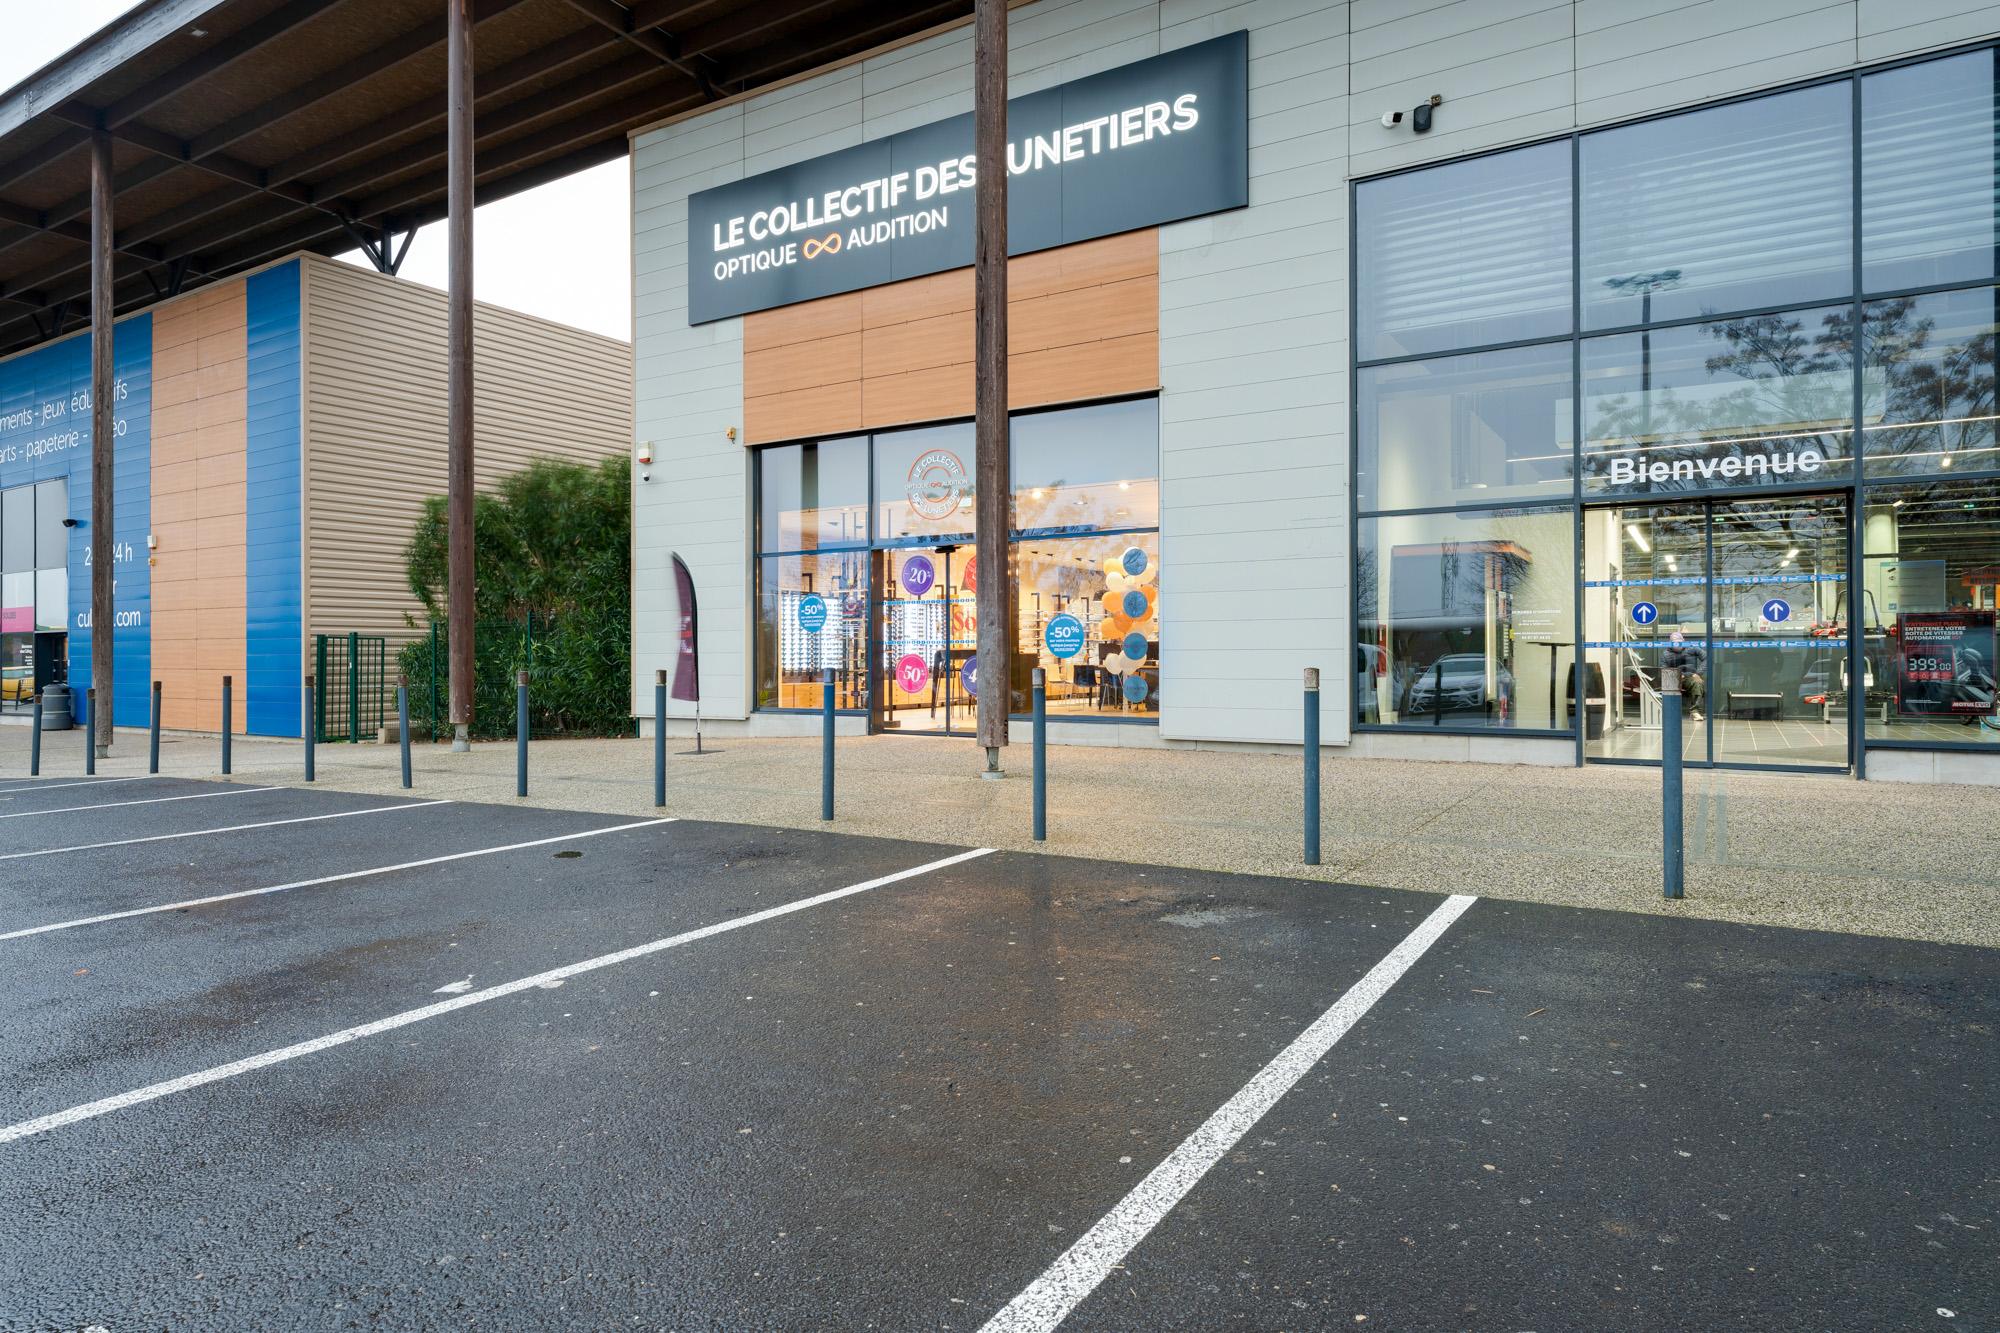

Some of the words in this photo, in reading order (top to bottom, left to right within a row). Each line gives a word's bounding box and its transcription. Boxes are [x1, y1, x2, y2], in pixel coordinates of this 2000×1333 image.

[713, 216, 745, 251] LE
[749, 172, 909, 241] COLLECTIF
[915, 154, 976, 200] DES
[1006, 93, 1200, 176] UNETIERS
[714, 243, 798, 281] OPTIQUE
[846, 206, 948, 250] AUDITION
[41, 400, 66, 426] jeux
[71, 379, 128, 412] éduifs
[26, 428, 79, 462] papeterie
[921, 455, 959, 475] COLLECTIF
[1610, 450, 1821, 485] Bienvenue
[77, 608, 141, 628] cul.com
[1050, 626, 1080, 638] -50%
